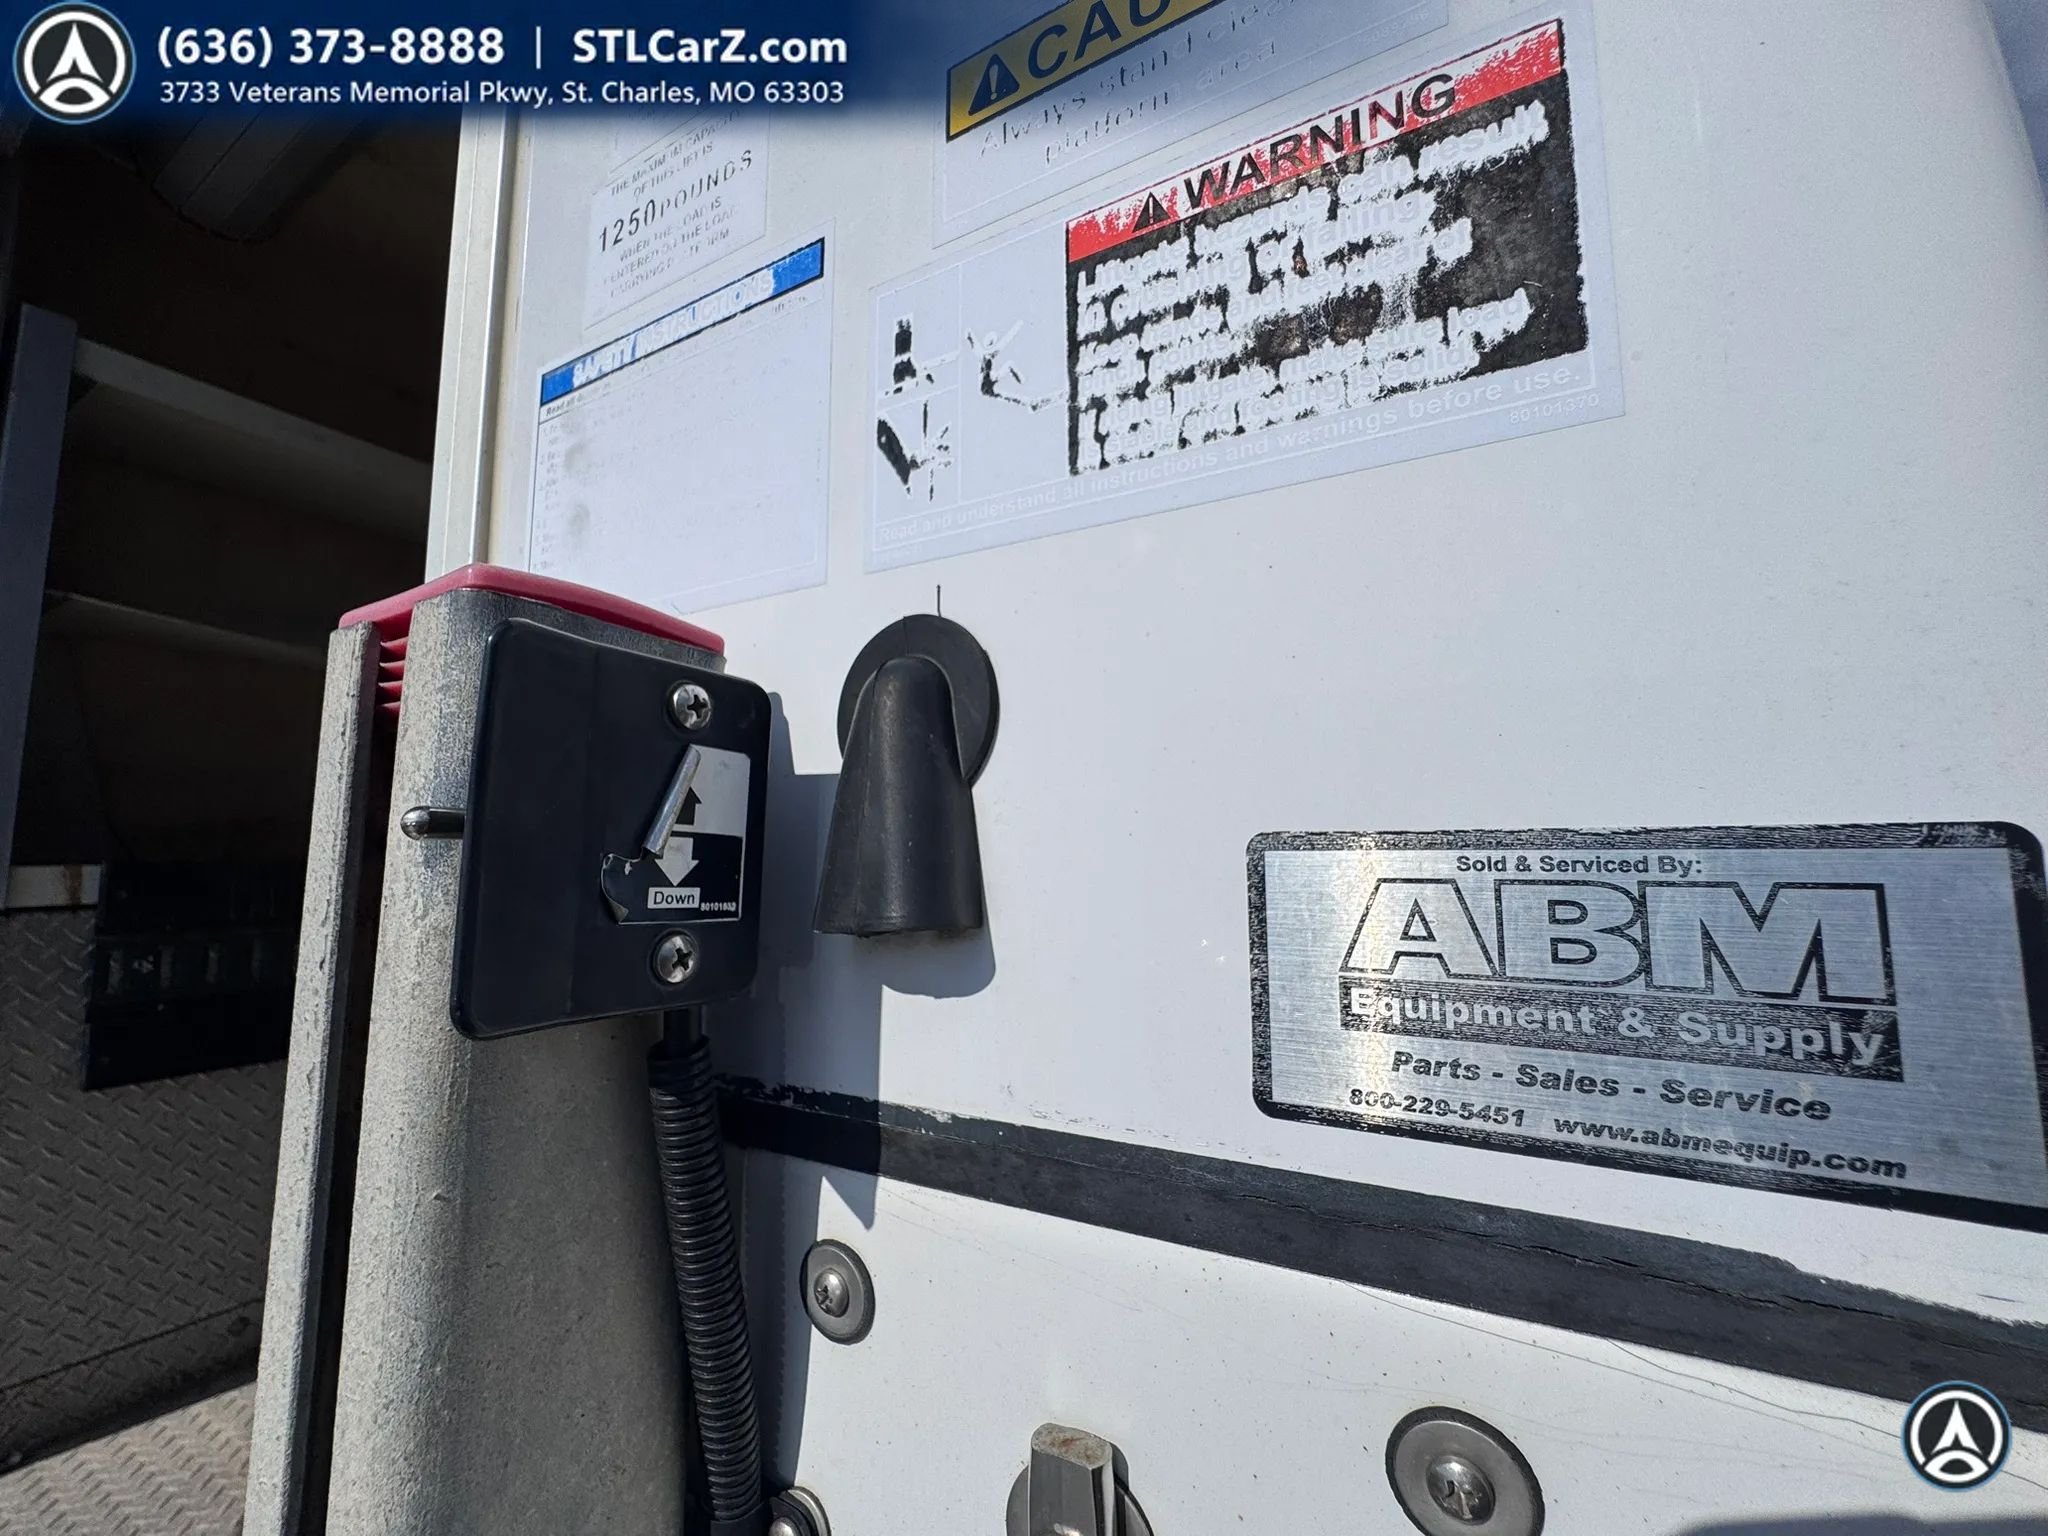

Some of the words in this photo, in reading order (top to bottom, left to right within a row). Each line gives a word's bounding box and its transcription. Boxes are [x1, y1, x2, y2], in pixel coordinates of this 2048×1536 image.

[1183, 72, 1456, 210] WARNING
[599, 199, 656, 252] 1250
[660, 150, 753, 219] POUNDS
[1225, 437, 1270, 463] and
[1408, 383, 1502, 419] before
[1514, 366, 1581, 395] use.
[653, 891, 695, 905] Down
[1456, 855, 1507, 873] Sold
[1514, 856, 1532, 873] &
[1539, 855, 1649, 875] Serviced
[1657, 856, 1702, 879] By:
[1338, 877, 1898, 1006] ABM
[1350, 986, 1593, 1036] Equipment
[1617, 1006, 1656, 1037] &
[1678, 1011, 1885, 1067] Supply
[1391, 1050, 1481, 1081] Parts
[1516, 1063, 1620, 1097] Sales
[1659, 1078, 1832, 1121] Service
[1349, 1088, 1525, 1127] 800-229-5451
[1554, 1117, 1907, 1179] www.abmequip.com
